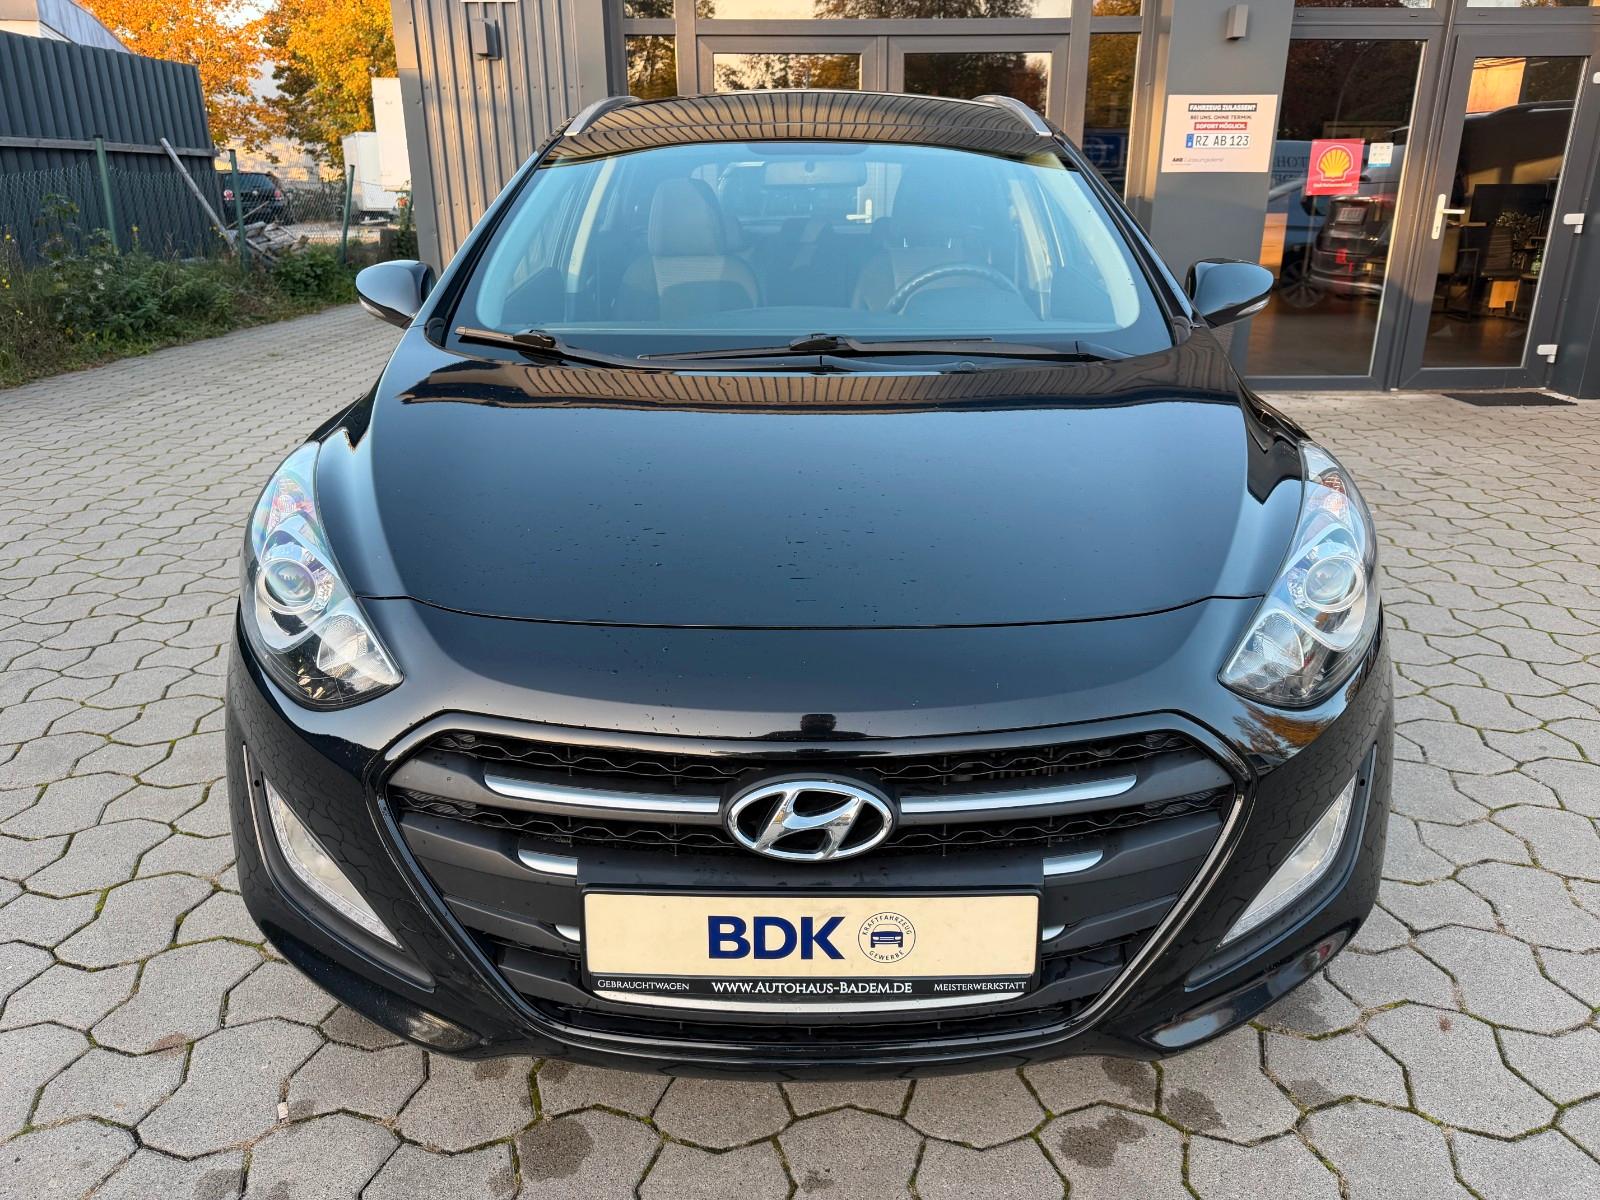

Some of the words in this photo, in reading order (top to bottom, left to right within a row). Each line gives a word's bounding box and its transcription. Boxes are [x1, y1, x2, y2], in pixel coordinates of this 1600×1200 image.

[1195, 135, 1209, 146] RZ
[1213, 135, 1227, 146] AB
[1229, 135, 1249, 146] 123
[862, 914, 912, 936] KRAFTFAHRZEUG
[707, 915, 846, 960] BDK
[869, 949, 904, 961] GEWERBE
